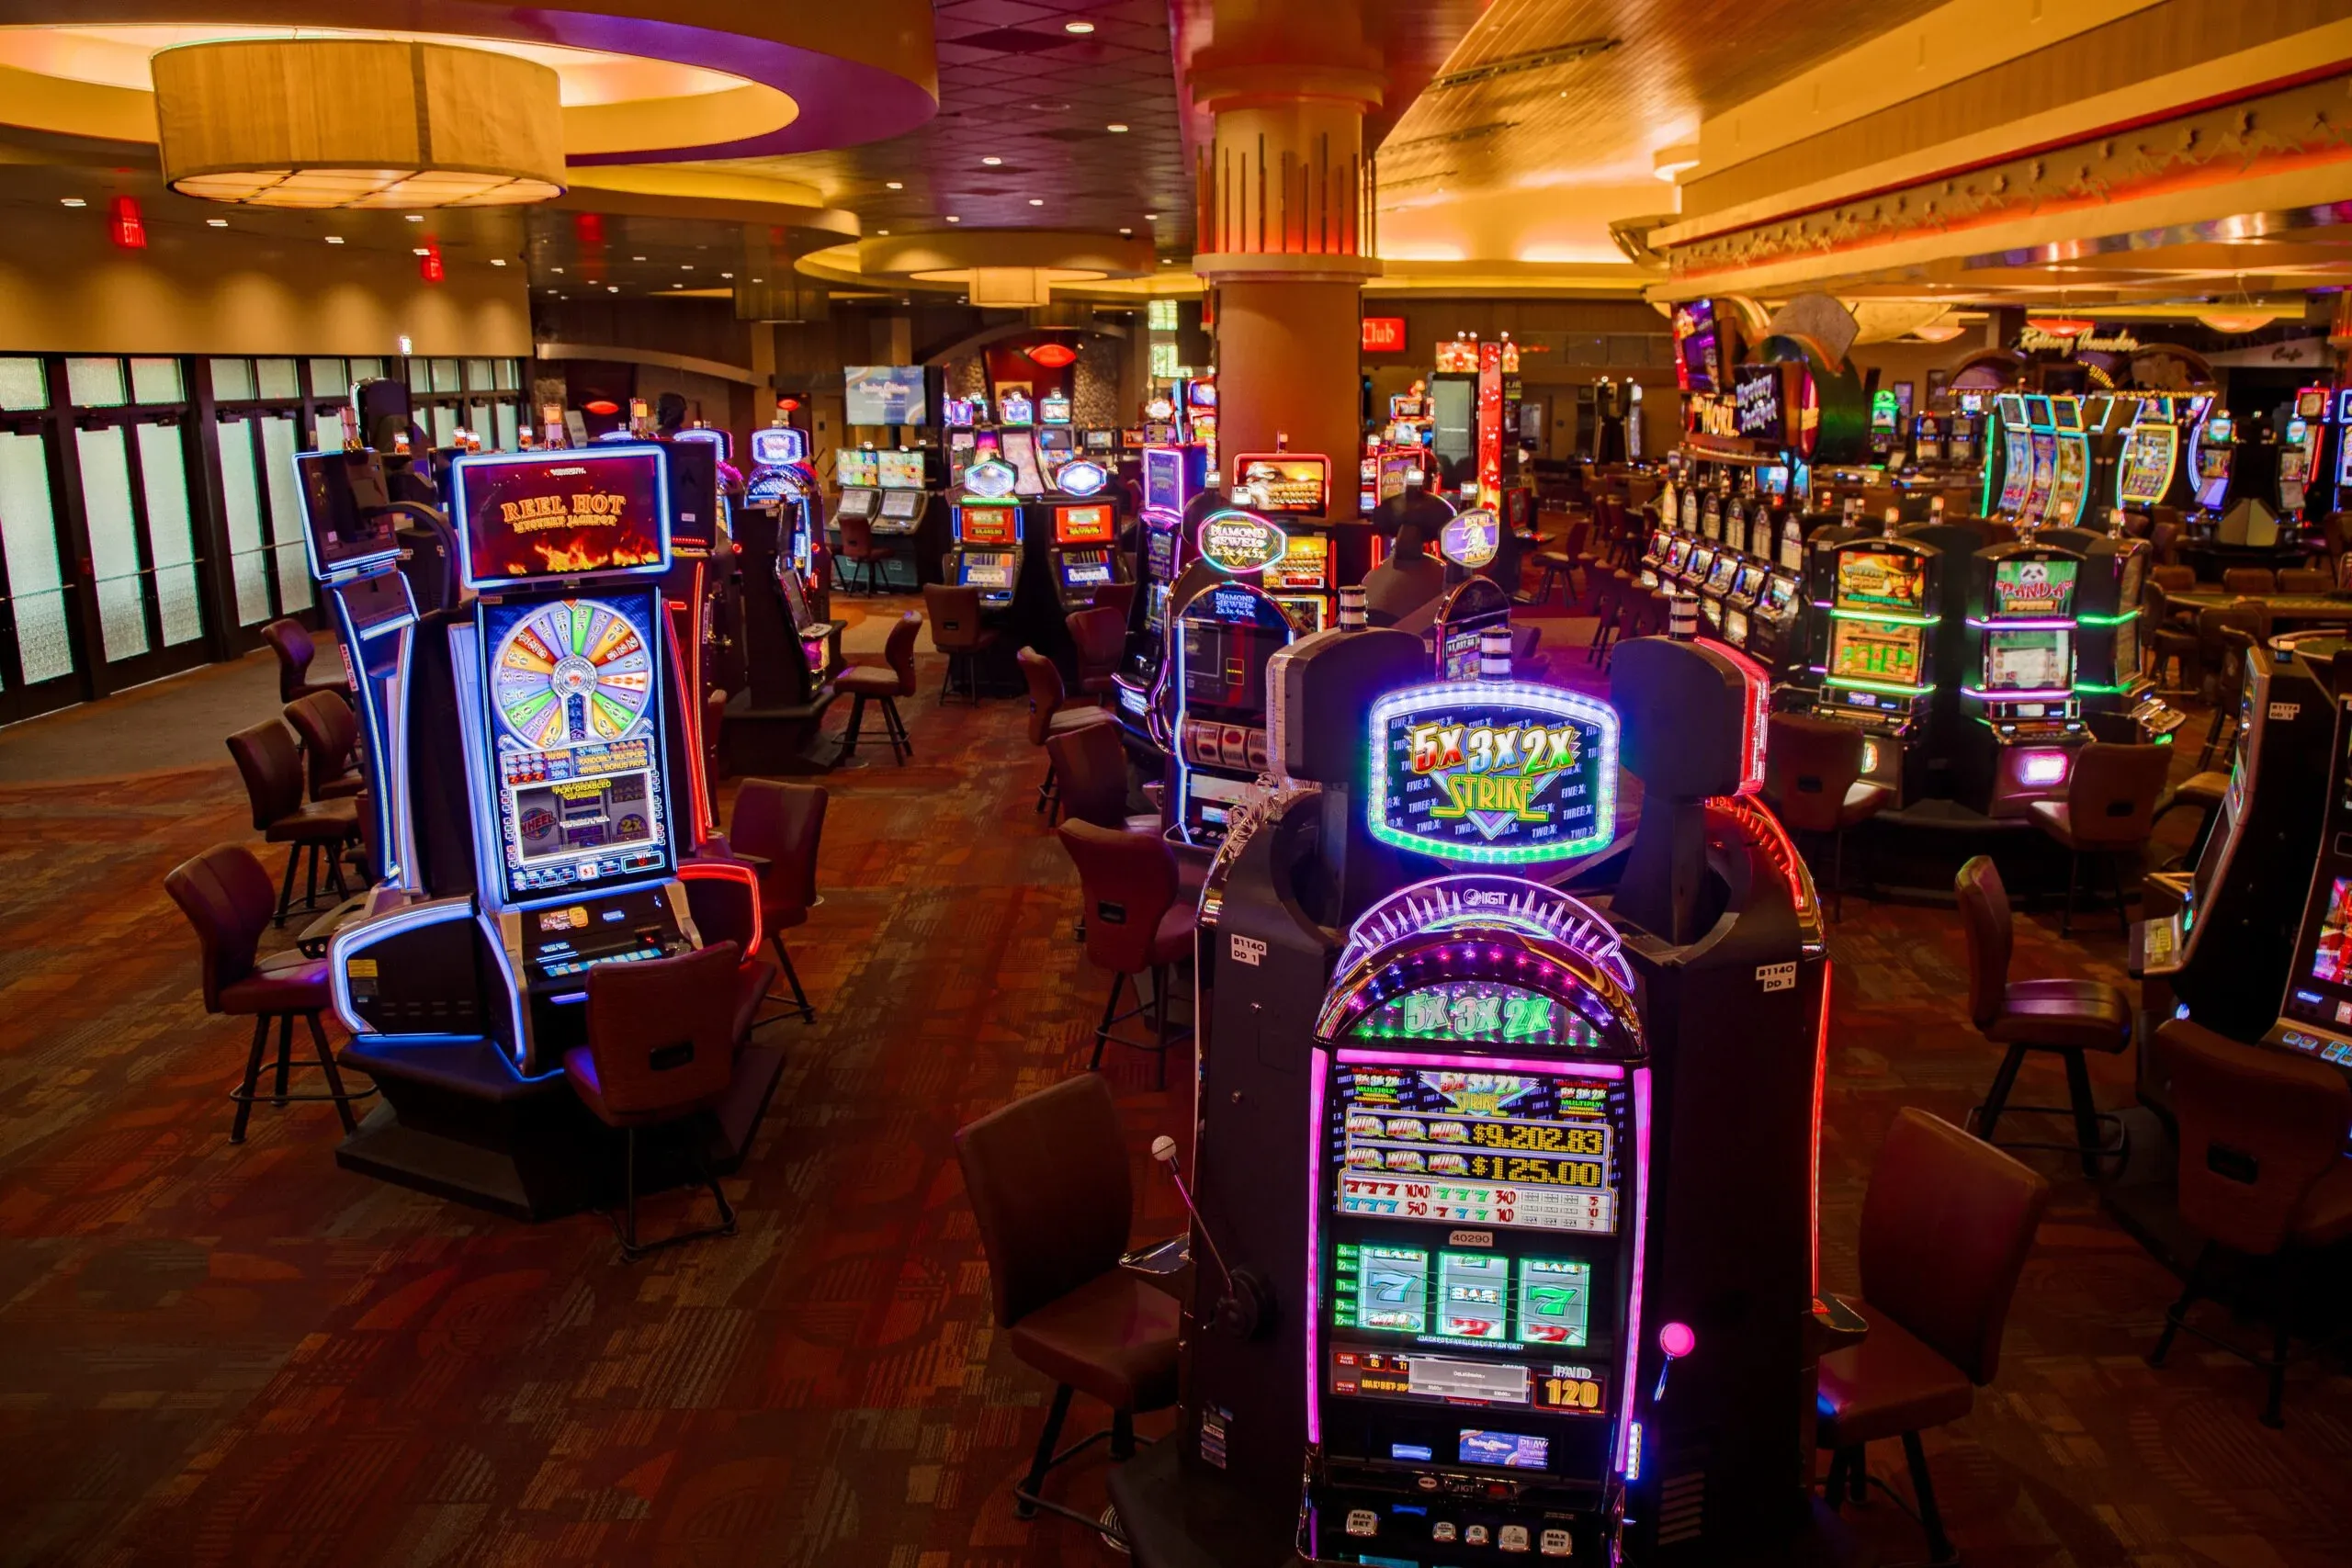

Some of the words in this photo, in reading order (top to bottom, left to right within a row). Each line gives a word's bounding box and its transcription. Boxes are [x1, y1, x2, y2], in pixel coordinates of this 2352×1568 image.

[1363, 322, 1395, 343] Club
[501, 496, 567, 524] REEL
[572, 494, 626, 514] HOT
[514, 516, 566, 533] MYSTERY
[567, 514, 617, 528] JACKPOT
[1210, 525, 1268, 538] DIAMOND
[1216, 592, 1256, 603] DIAMOND
[2002, 582, 2065, 599] PANDA
[1412, 722, 1465, 774] 5X
[1467, 726, 1520, 774] 3X
[1521, 725, 1575, 777] 2X
[579, 754, 612, 765] RANDOMLY
[579, 764, 604, 774] WHEEL
[605, 761, 628, 771] BONUS
[553, 785, 575, 795] PLAY
[576, 780, 612, 792] DISABLED
[1407, 779, 1423, 792] FIVE
[1562, 785, 1578, 798] FIVE
[1430, 773, 1549, 822] STRIKE
[1408, 799, 1430, 814] THREE
[1563, 806, 1585, 820] THREE
[1417, 820, 1433, 833] TWO
[1532, 825, 1548, 838] TWO
[1481, 892, 1508, 905] IGT
[1234, 950, 1247, 959] DD
[1767, 980, 1781, 988] DD
[1405, 994, 1448, 1033] 5X
[1454, 997, 1501, 1035] 3X
[1503, 998, 1552, 1038] 2X
[1441, 1072, 1468, 1092] 5X
[1468, 1073, 1494, 1094] 3X
[1495, 1075, 1521, 1095] 2X
[1445, 1092, 1509, 1116] STRIKE
[1472, 1156, 1600, 1187] $125.00
[1453, 1234, 1489, 1244] 40290
[1369, 1271, 1418, 1303] 7
[1451, 1287, 1498, 1304] BAR
[1528, 1285, 1577, 1316] 7
[1553, 1365, 1591, 1379] PAID
[1546, 1379, 1599, 1407] 120
